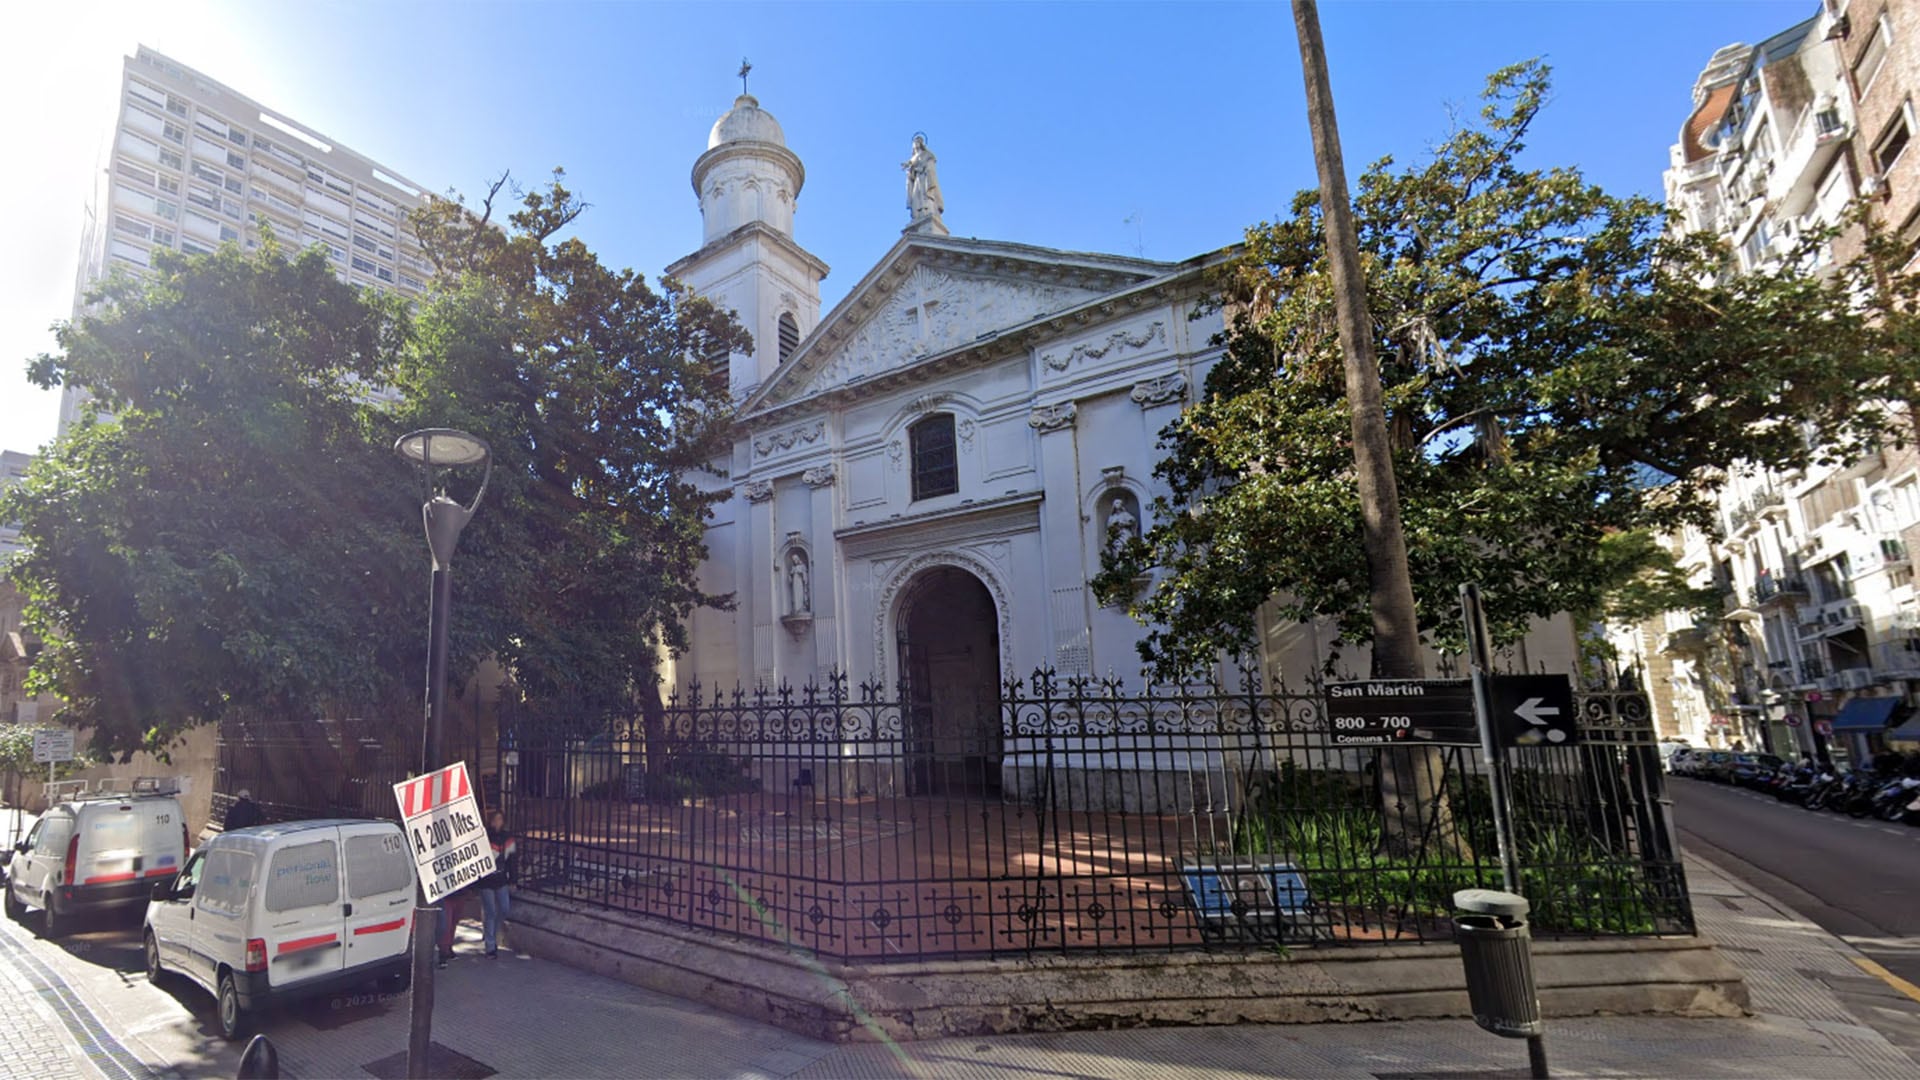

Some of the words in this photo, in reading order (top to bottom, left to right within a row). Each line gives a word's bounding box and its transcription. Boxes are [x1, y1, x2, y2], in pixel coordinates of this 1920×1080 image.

[1331, 686, 1363, 698] San
[1335, 717, 1366, 729] 800
[1380, 716, 1411, 728] 700
[1336, 735, 1383, 744] Comuna
[1386, 734, 1392, 742] 1
[156, 814, 170, 825] 110
[383, 834, 402, 852] 110
[413, 828, 427, 855] A
[425, 819, 452, 849] 200
[431, 842, 479, 876] CERRADO
[276, 859, 332, 877] personal
[305, 874, 332, 885] flow
[428, 883, 443, 898] AL
[442, 855, 493, 891] TRANSITO
